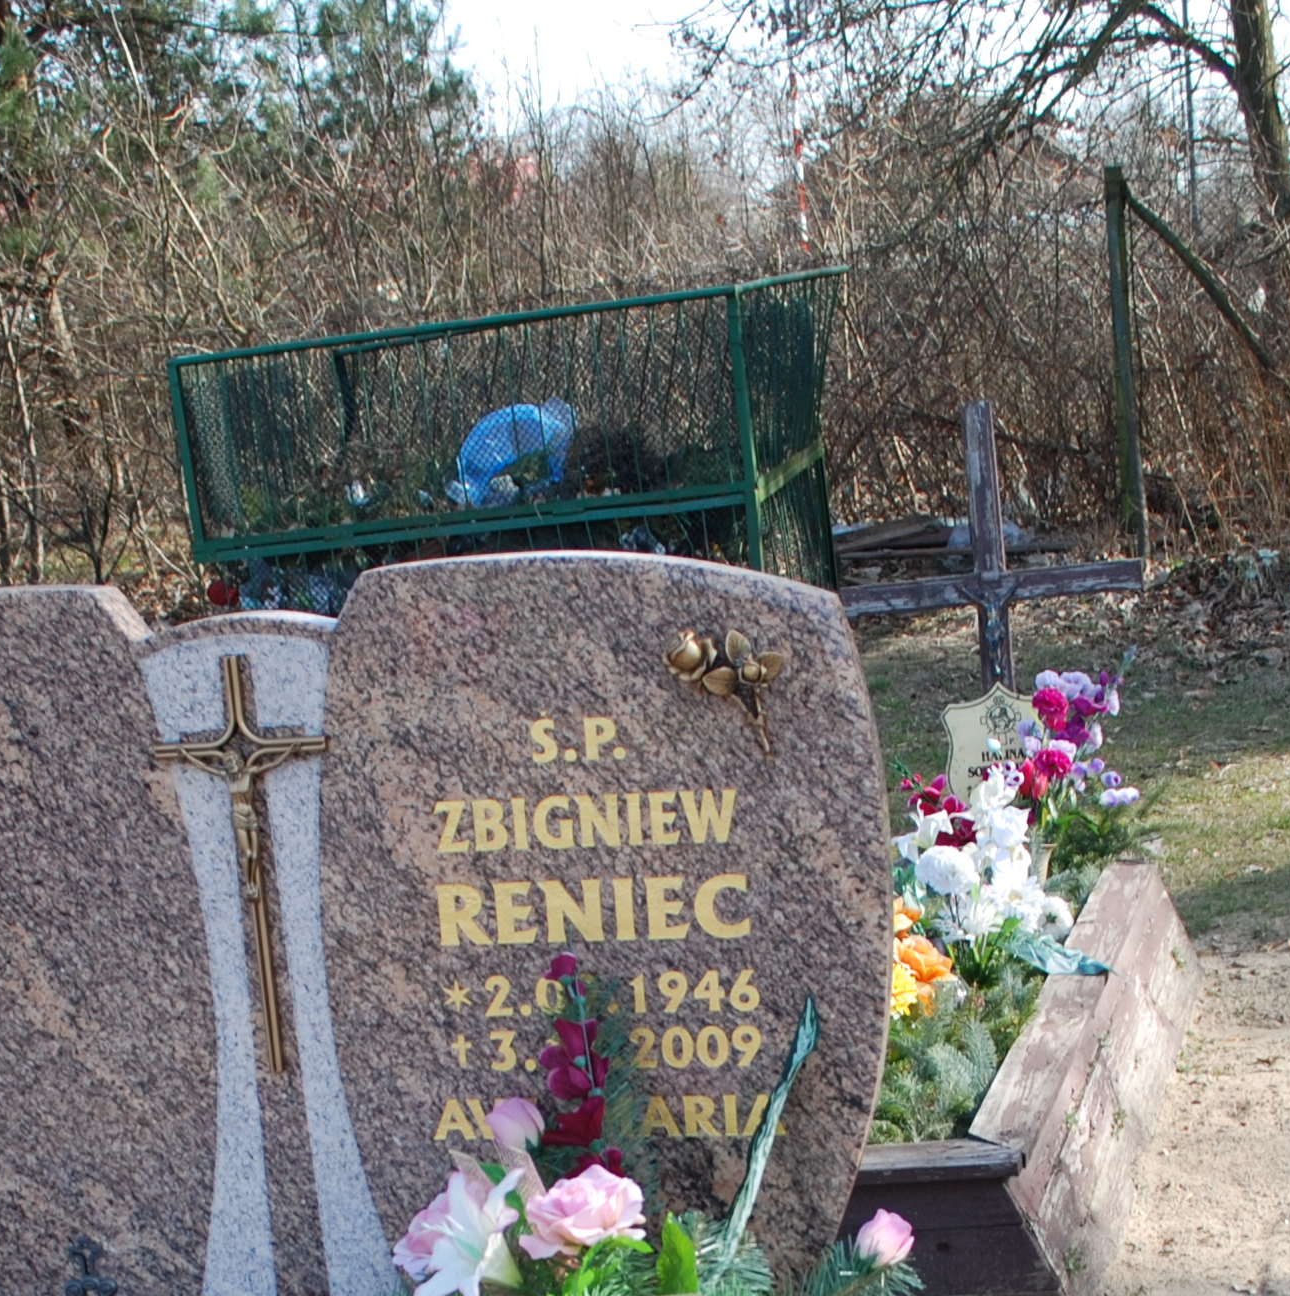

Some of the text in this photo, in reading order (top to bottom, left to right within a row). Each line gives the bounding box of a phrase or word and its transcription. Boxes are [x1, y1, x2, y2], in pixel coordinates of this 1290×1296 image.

[432, 788, 738, 853] ZBIGNIEW
[436, 872, 752, 948] RENIEC
[484, 969, 760, 1017] 2.0.1946
